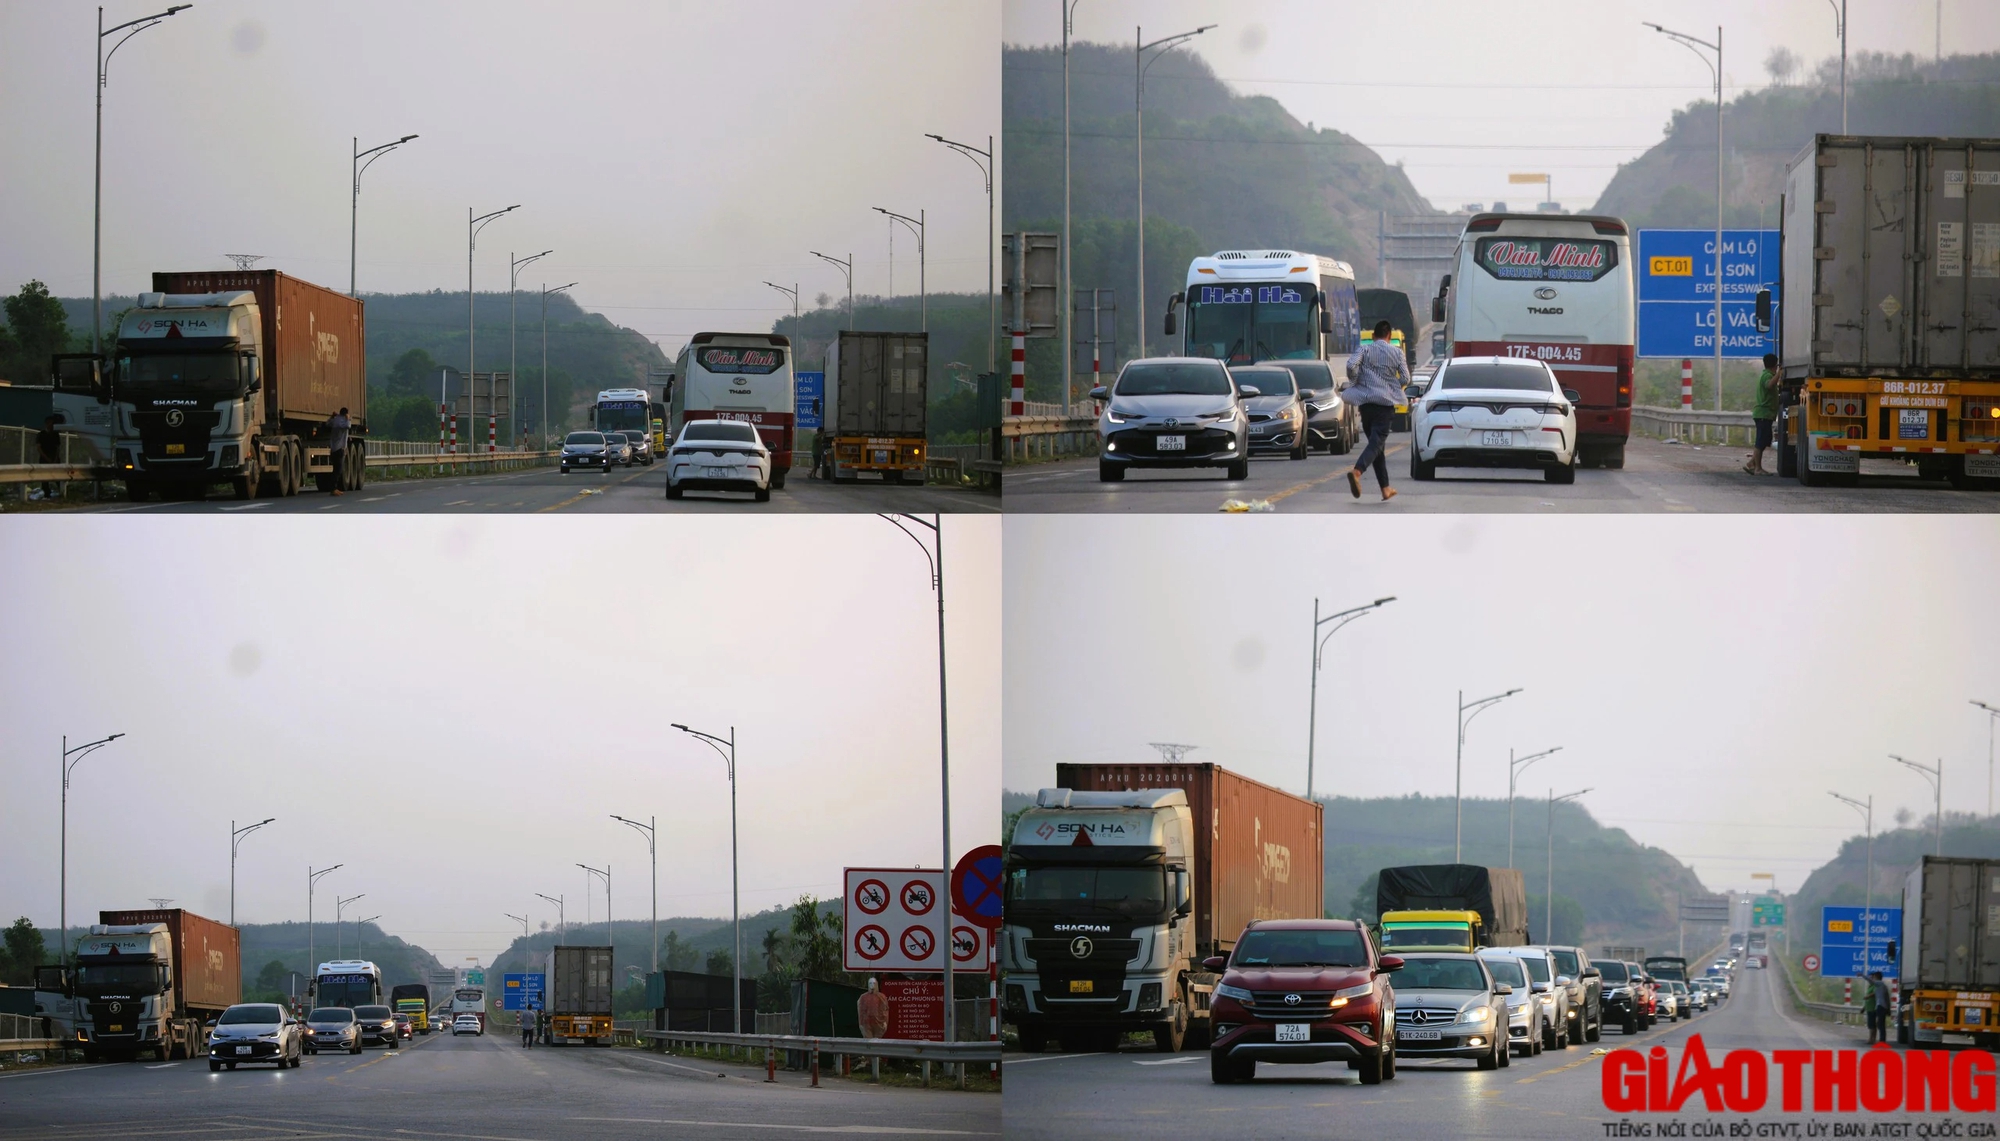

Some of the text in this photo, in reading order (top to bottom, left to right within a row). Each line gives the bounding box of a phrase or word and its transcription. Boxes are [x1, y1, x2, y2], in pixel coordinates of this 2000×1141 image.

[1738, 238, 1757, 258] LỘ
[1488, 241, 1603, 268] Văn Minh
[1654, 260, 1688, 272] CT.01
[1726, 262, 1755, 276] SƠN
[1201, 286, 1302, 304] Hải Hà
[1527, 307, 1564, 315] THACO
[1696, 309, 1720, 327] LÔ
[188, 320, 207, 328] HA
[1694, 336, 1763, 347] ENRANCE
[737, 350, 775, 366] Minh
[1884, 382, 1946, 394] 86R-012.37
[1814, 455, 1855, 463] YONGCHAO
[1100, 773, 1193, 783] APKU 2020016
[1100, 824, 1126, 834] HA
[1054, 924, 1110, 932] SHACMAN
[1852, 964, 1891, 972] ENRANCE
[902, 986, 920, 994] CHÚ
[1279, 1033, 1306, 1041] 574.01
